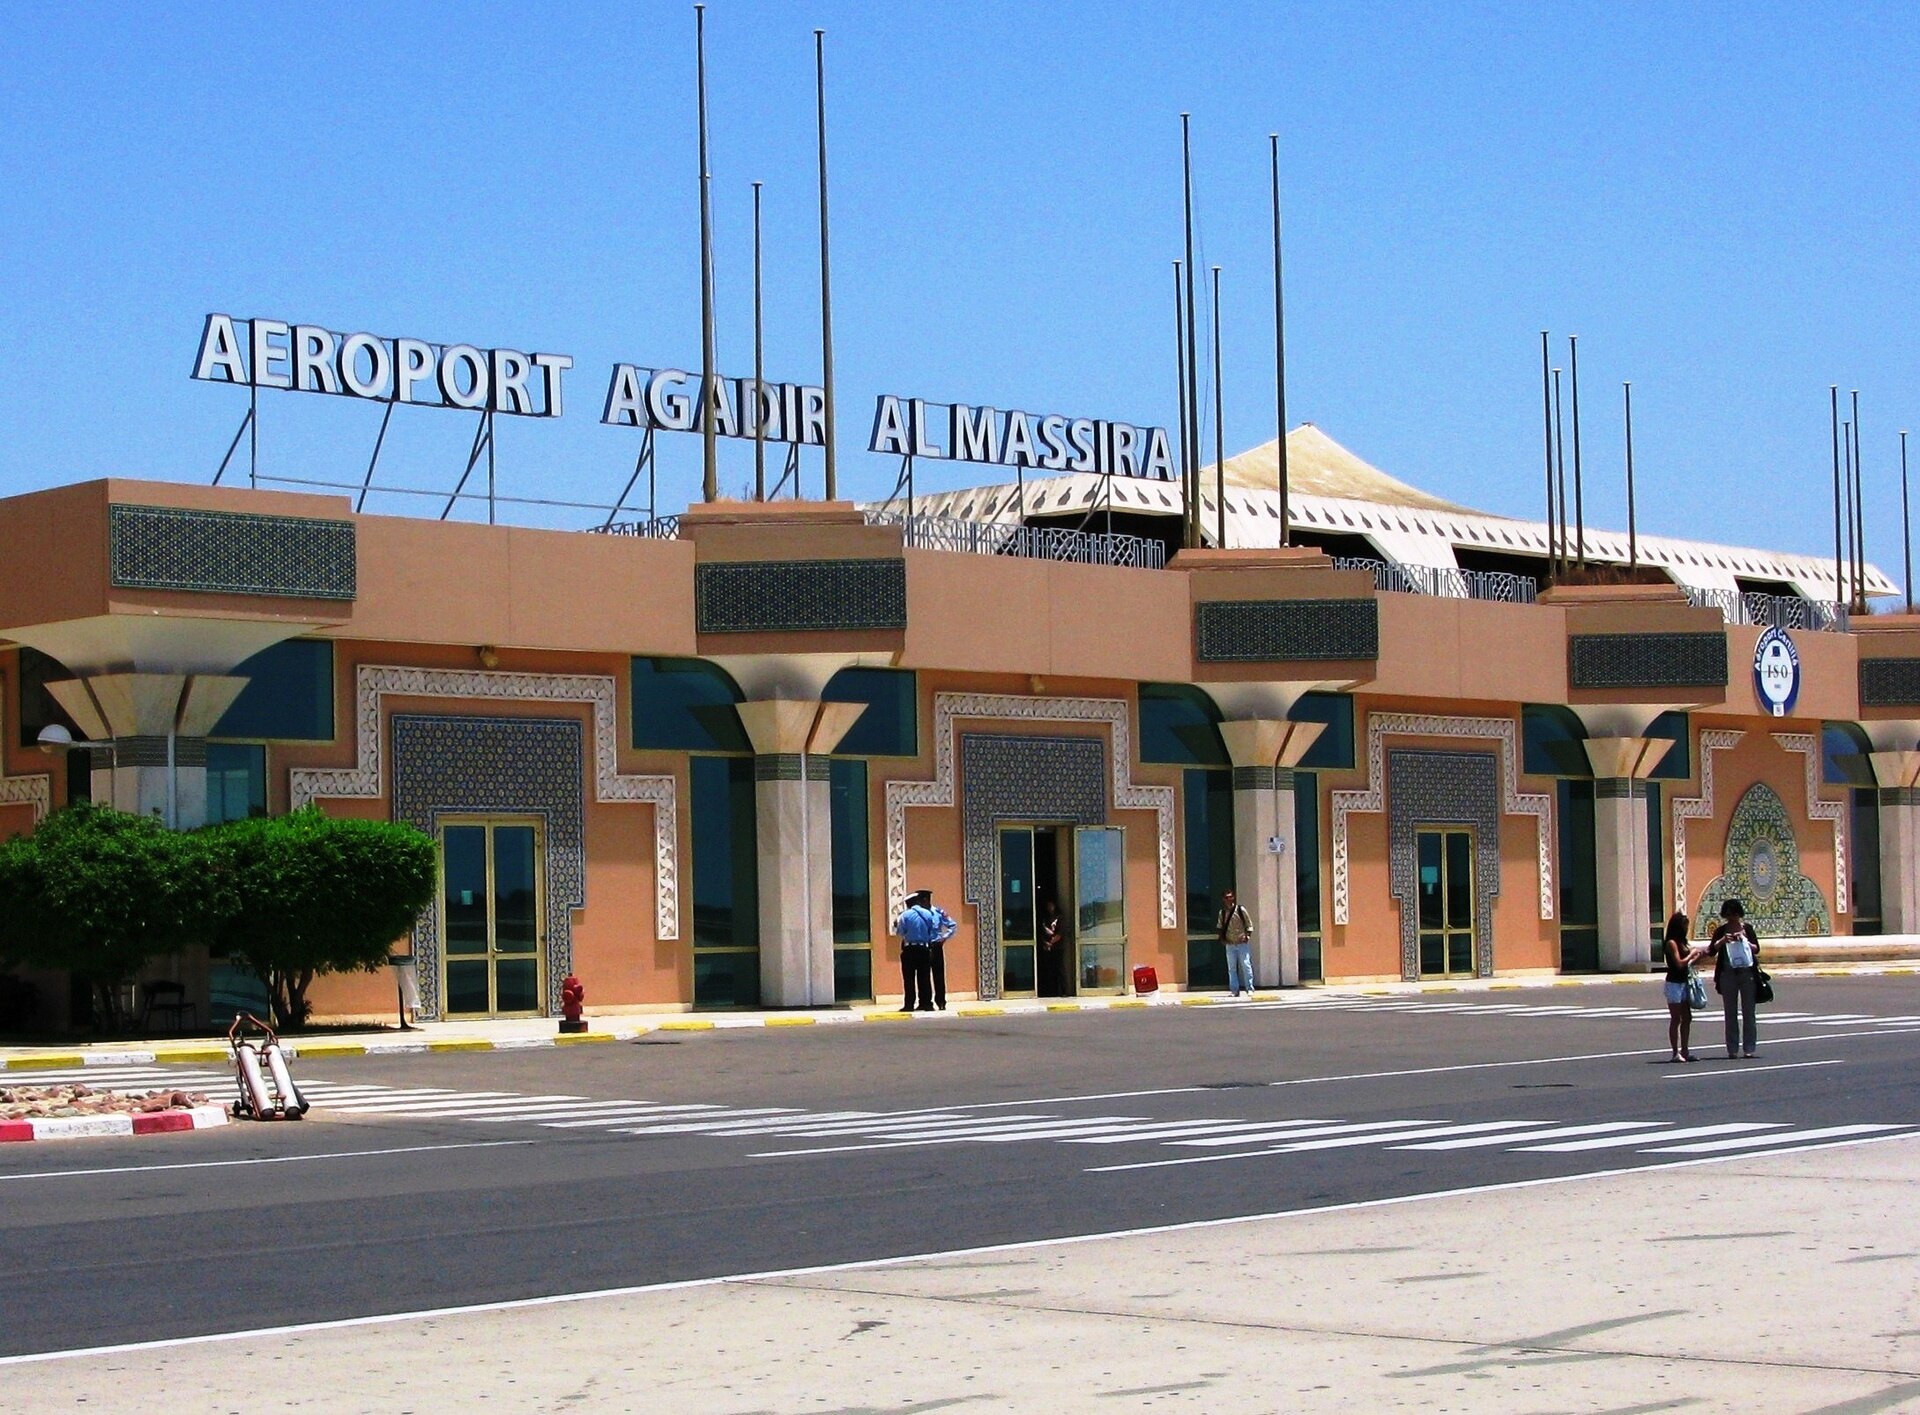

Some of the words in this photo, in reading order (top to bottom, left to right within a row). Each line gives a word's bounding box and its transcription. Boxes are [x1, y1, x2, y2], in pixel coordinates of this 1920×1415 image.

[191, 313, 573, 417] AEROPORT
[601, 363, 826, 446] AGADIR
[1767, 664, 1788, 679] ISO
